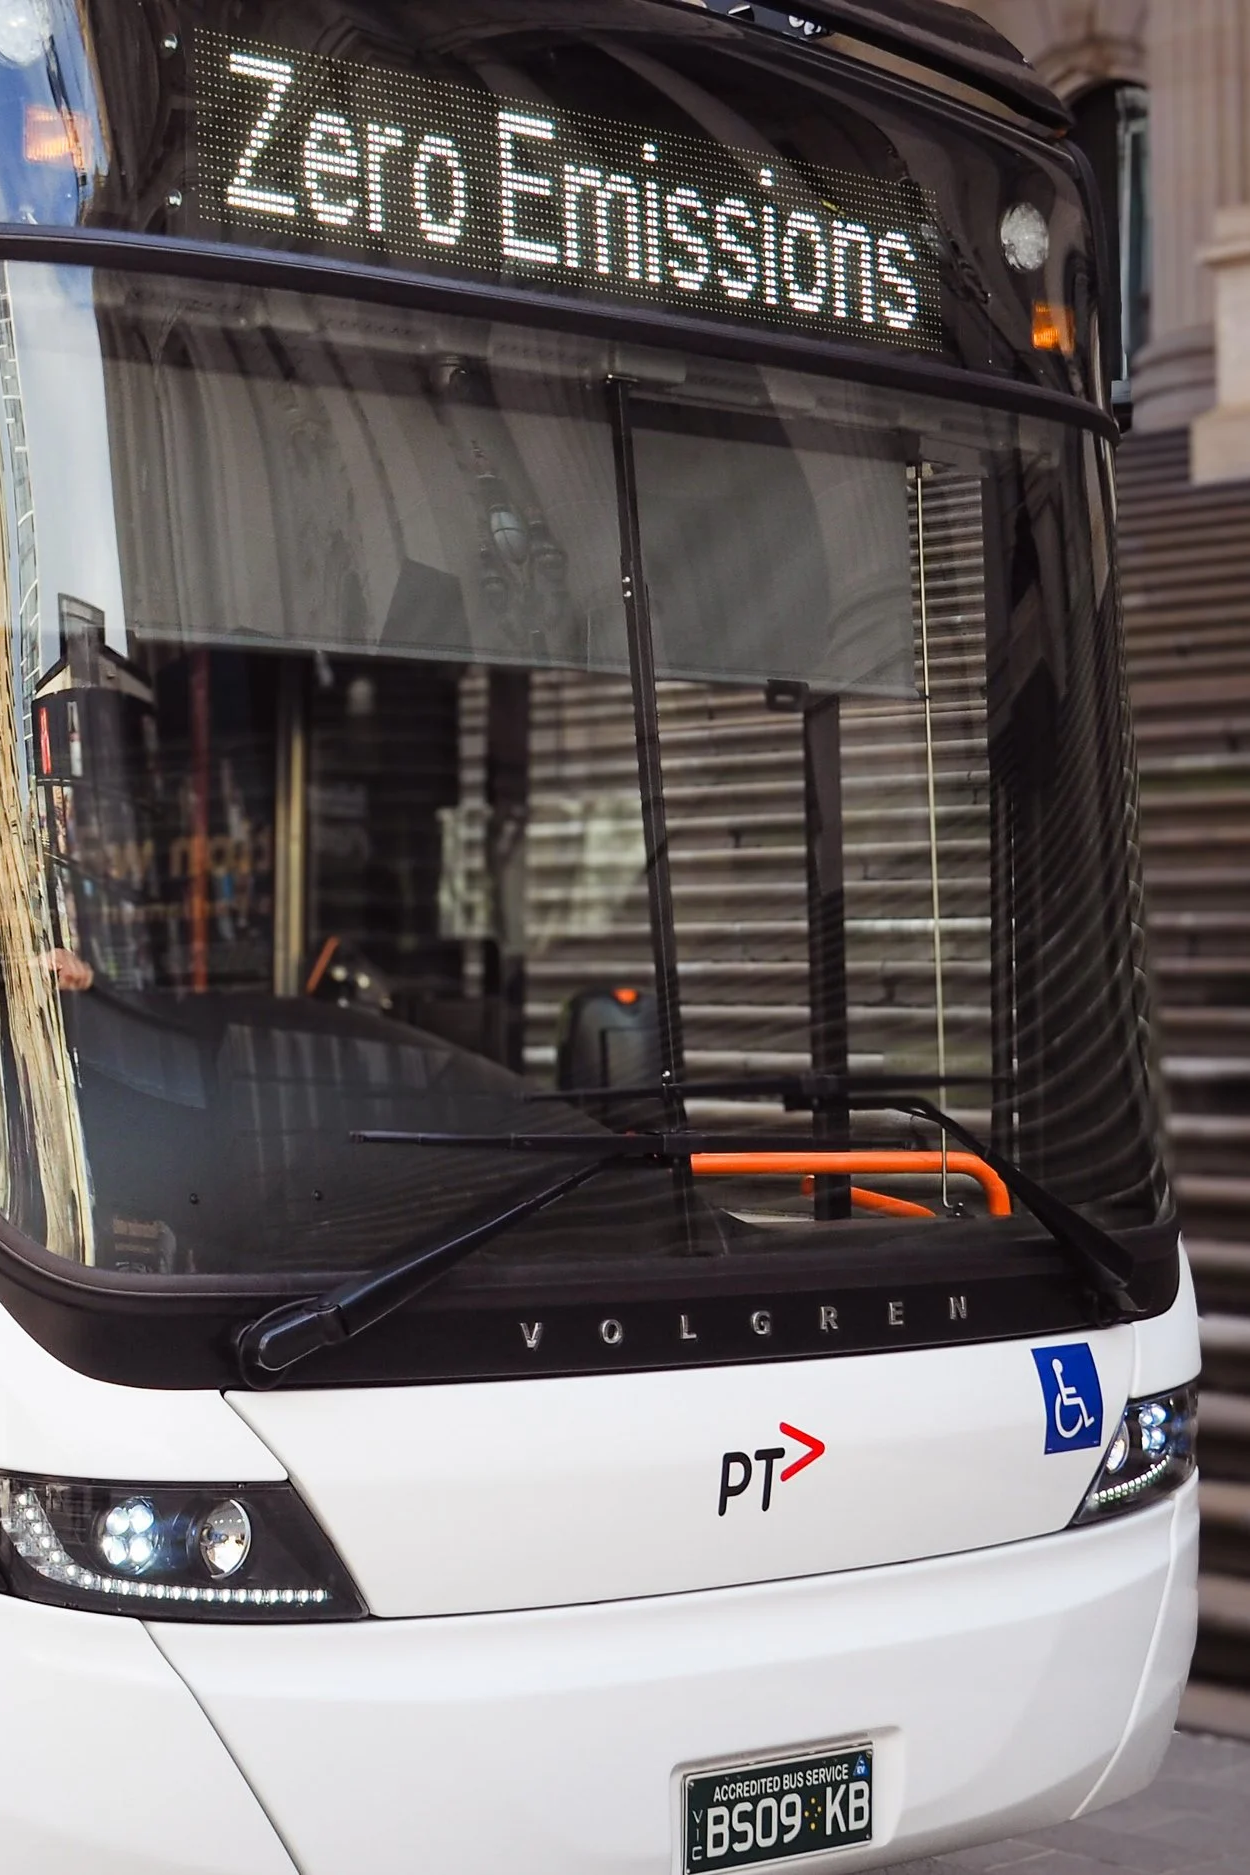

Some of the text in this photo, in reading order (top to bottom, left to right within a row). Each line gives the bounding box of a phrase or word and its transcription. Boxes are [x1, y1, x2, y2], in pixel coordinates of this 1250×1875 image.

[227, 52, 920, 330] Zero Emissions
[520, 1295, 969, 1352] VOLGREN
[713, 1763, 849, 1803] ACCREDITED BUS SERVICE
[826, 1780, 870, 1836] KB
